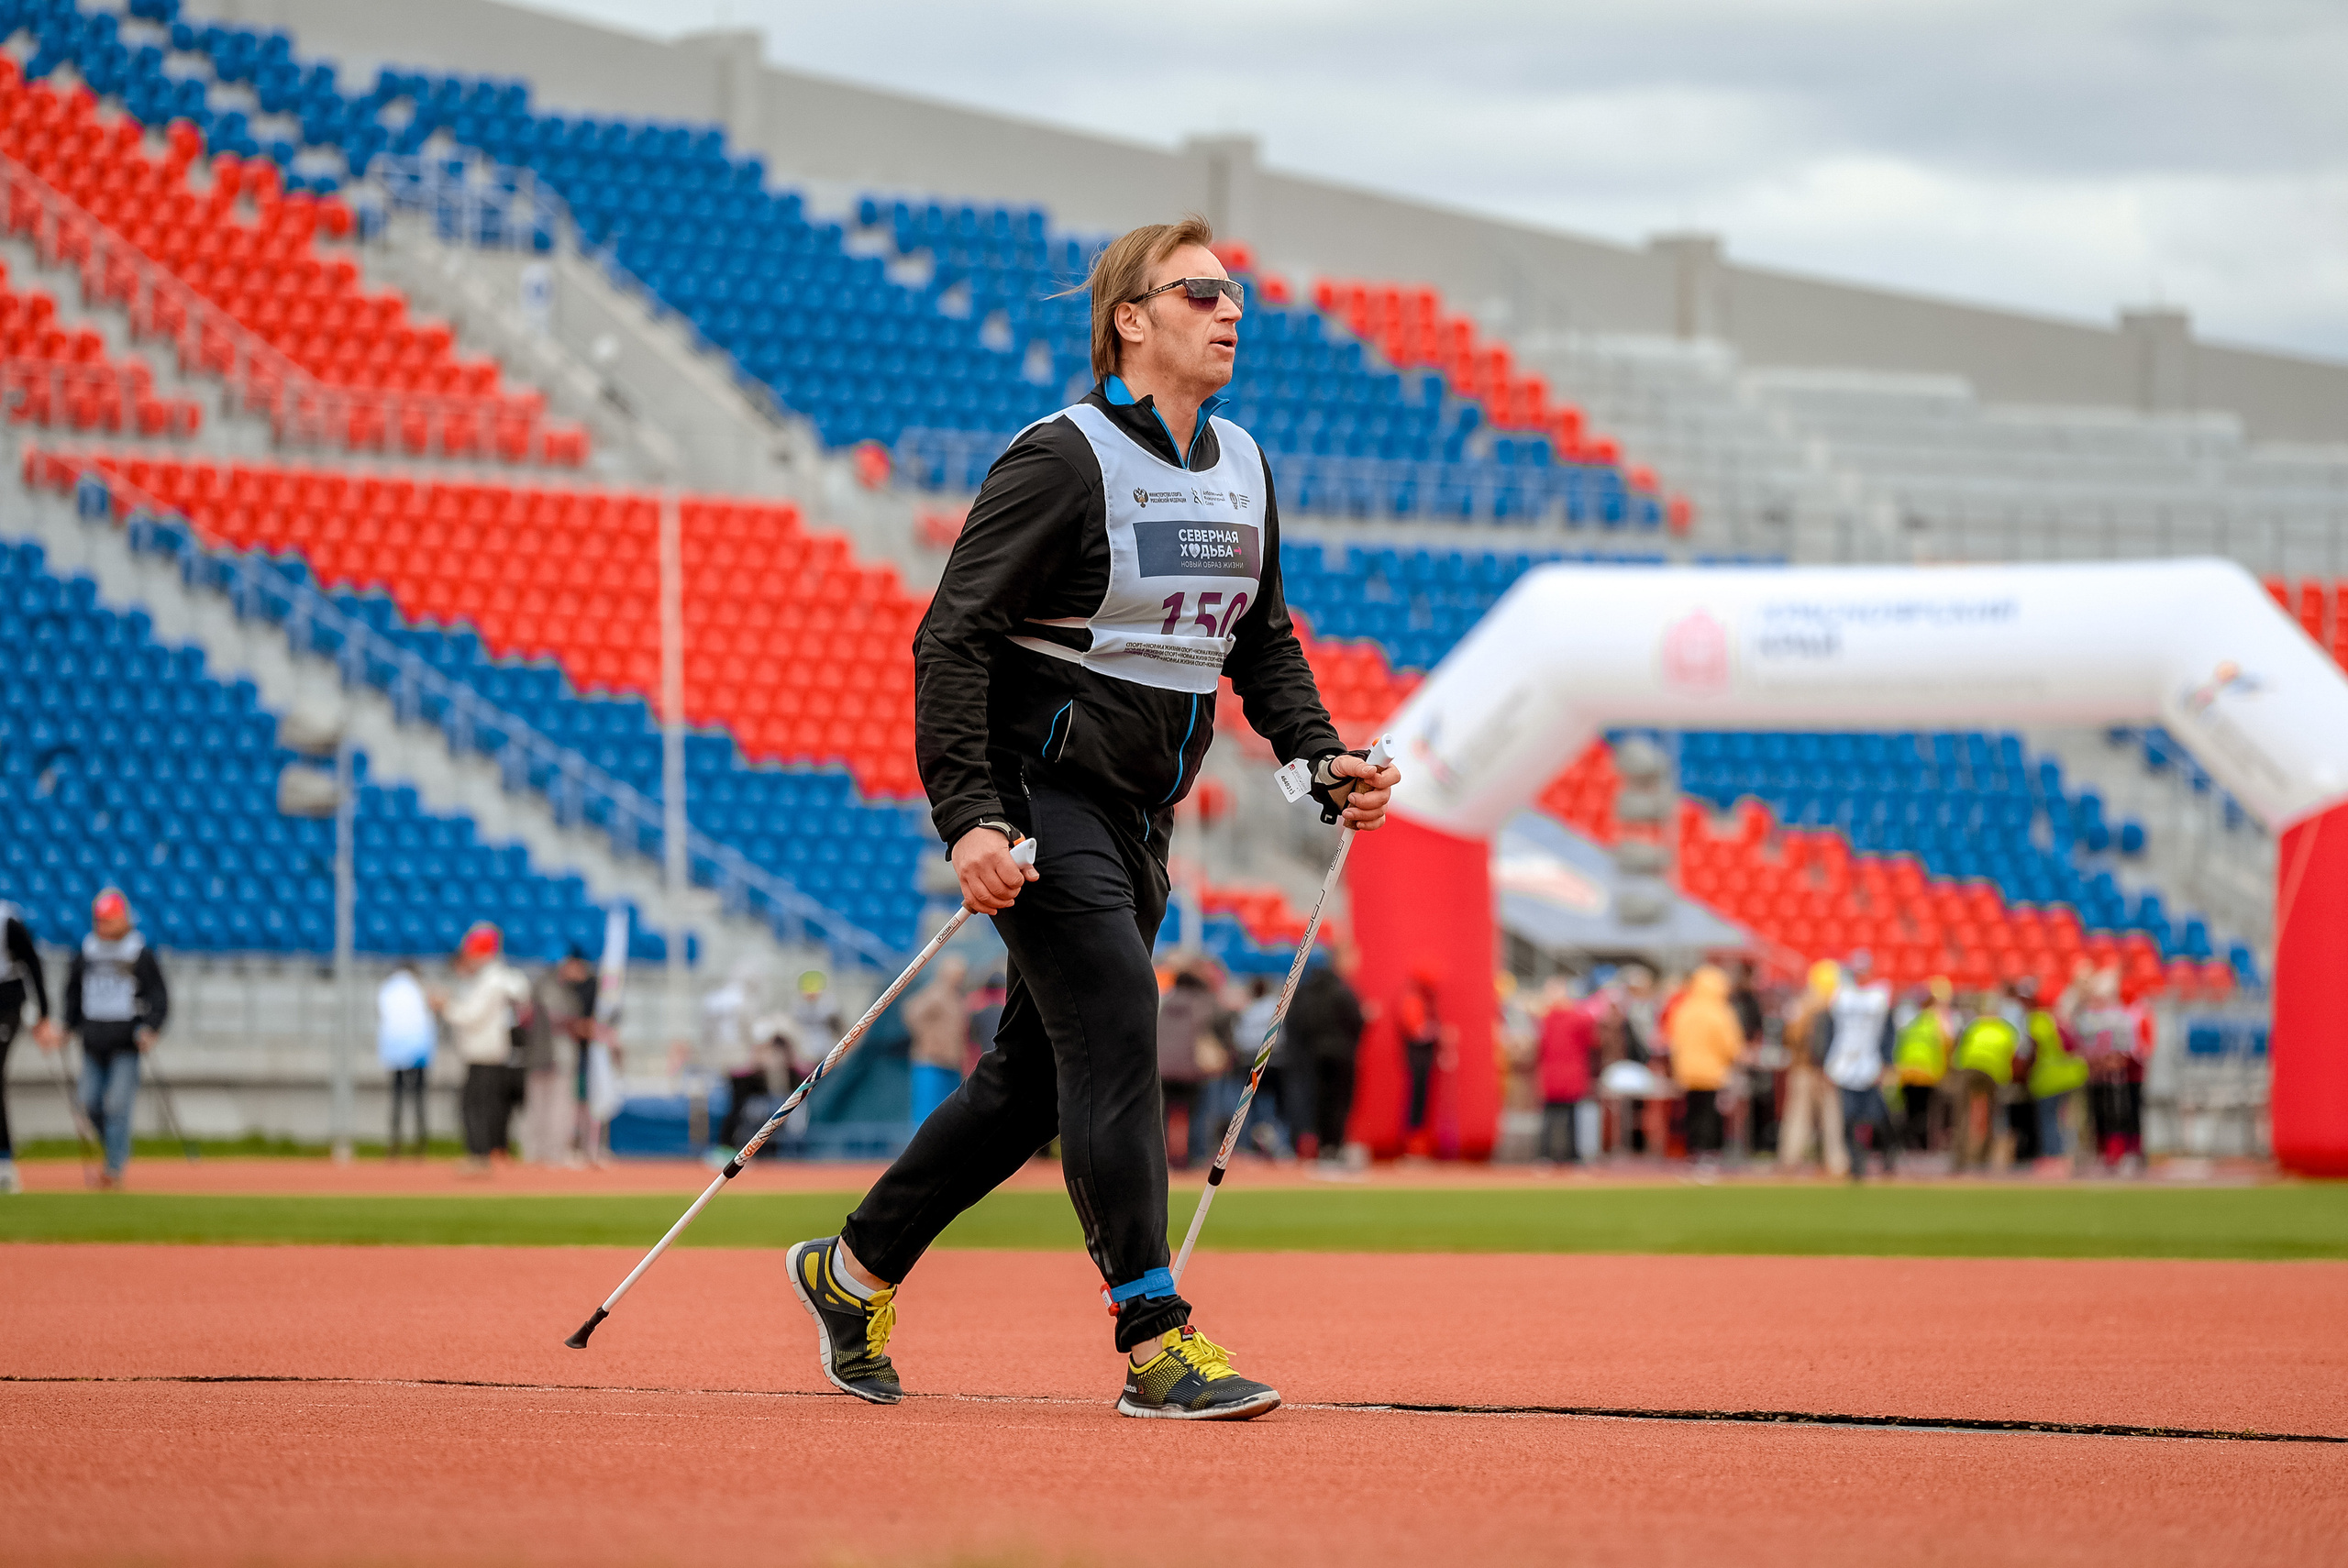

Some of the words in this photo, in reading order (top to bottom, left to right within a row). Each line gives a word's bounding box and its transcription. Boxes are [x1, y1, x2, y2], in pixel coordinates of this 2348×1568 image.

[1178, 528, 1239, 544] СЕВЕРНАЯ
[1180, 560, 1202, 569] НОВЫЙ
[1223, 561, 1245, 569] ЖИЗНИ
[1160, 591, 1248, 640] 150
[937, 924, 953, 942] MEDICA
